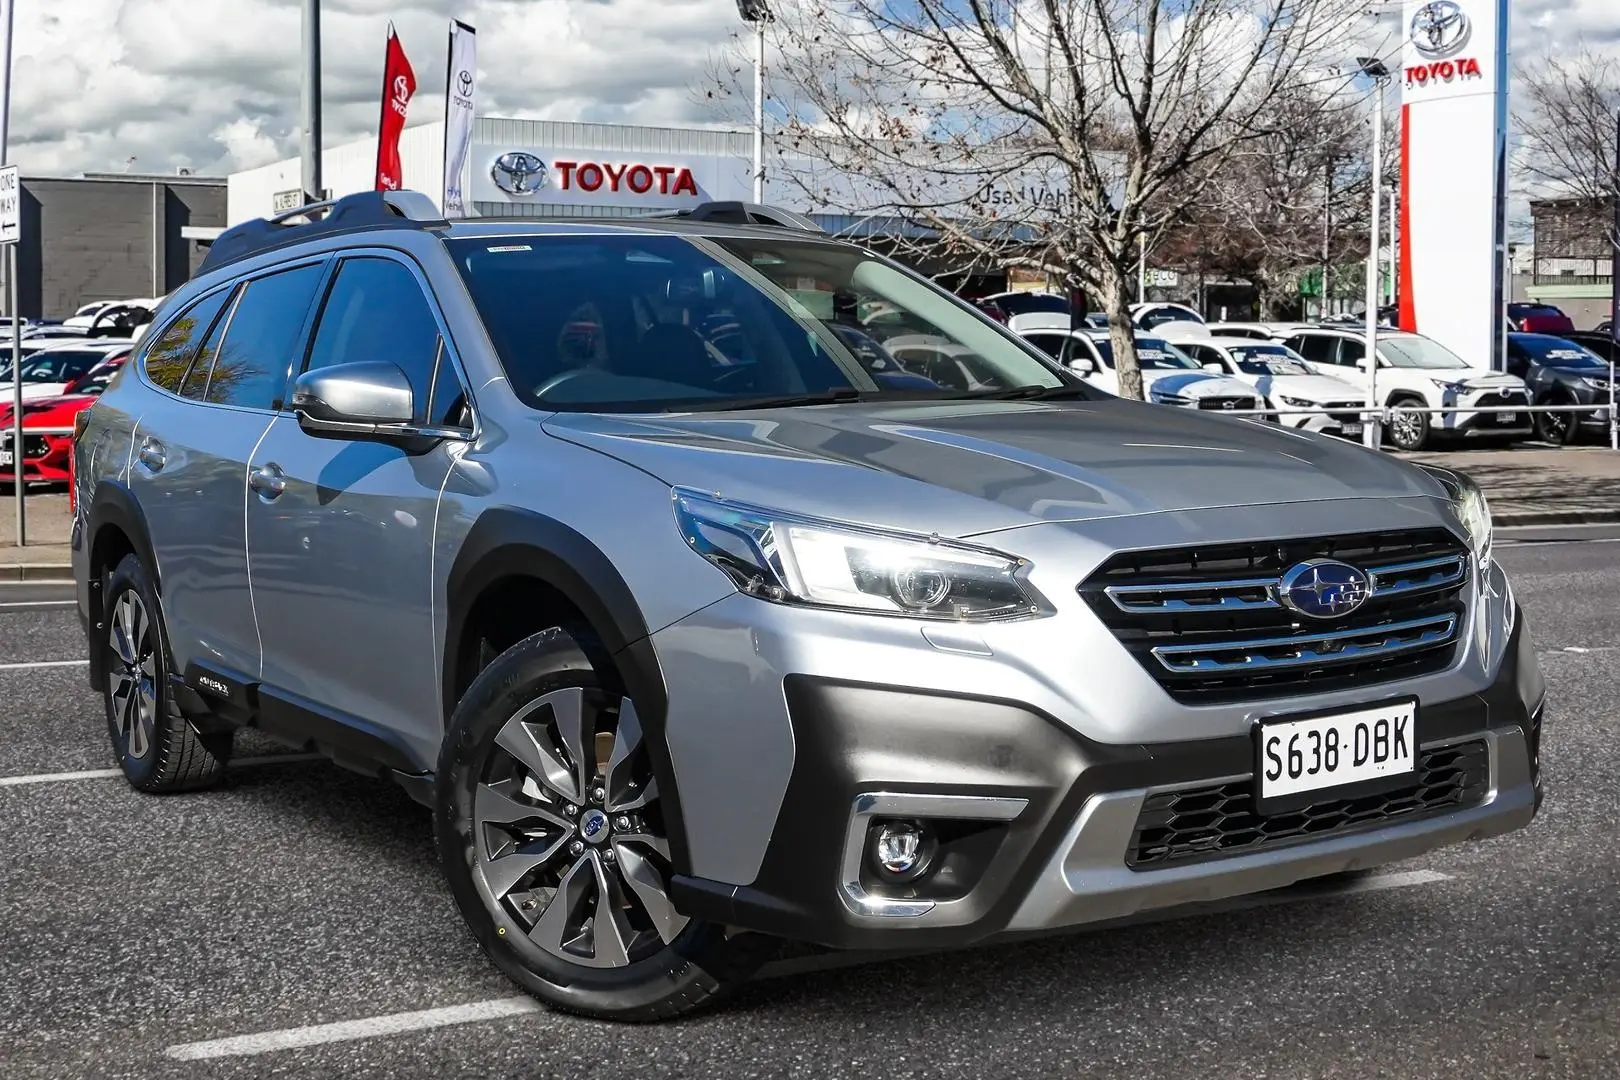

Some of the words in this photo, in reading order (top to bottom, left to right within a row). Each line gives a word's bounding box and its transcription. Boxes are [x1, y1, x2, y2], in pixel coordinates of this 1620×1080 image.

[1404, 58, 1482, 83] TOYOTA
[453, 95, 474, 110] TOYOTA
[1, 173, 15, 191] ONE
[555, 161, 698, 196] TOYOTA
[977, 182, 1025, 205] Used
[0, 196, 16, 213] WAY
